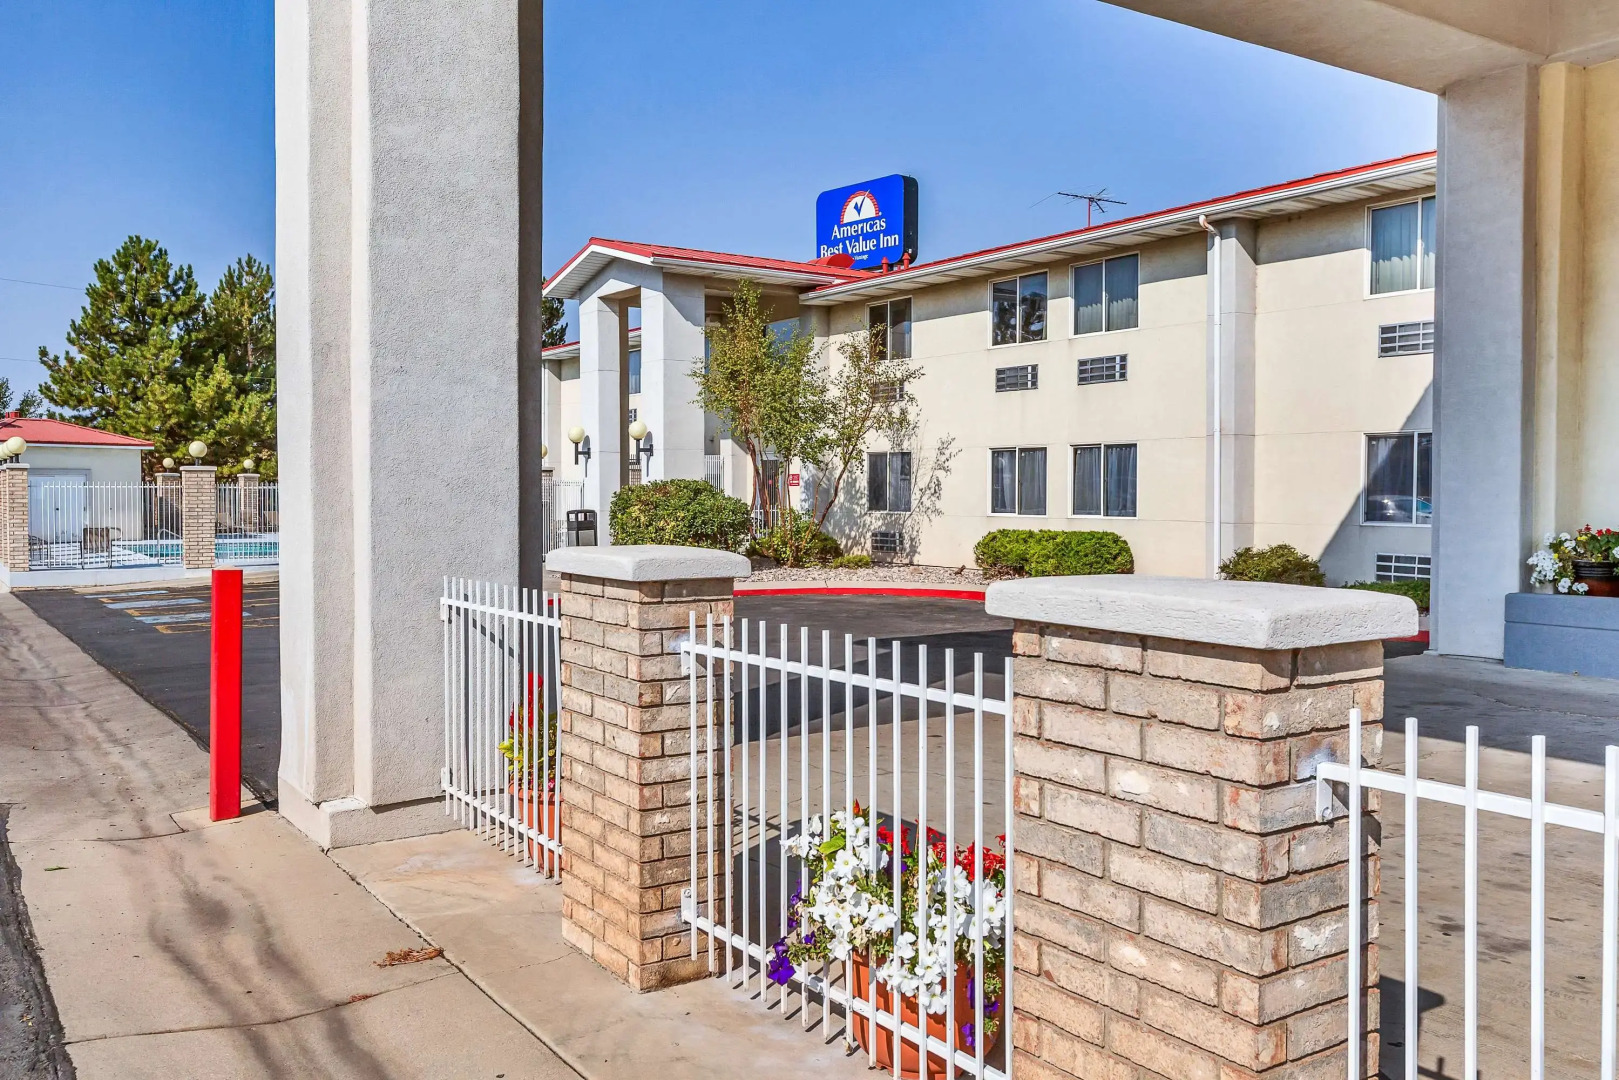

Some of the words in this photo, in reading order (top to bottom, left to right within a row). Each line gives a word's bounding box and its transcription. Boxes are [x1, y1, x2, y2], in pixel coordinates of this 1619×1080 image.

[832, 218, 886, 240] Americas
[820, 242, 843, 258] Best
[845, 236, 877, 254] Value
[880, 233, 899, 248] Inn
